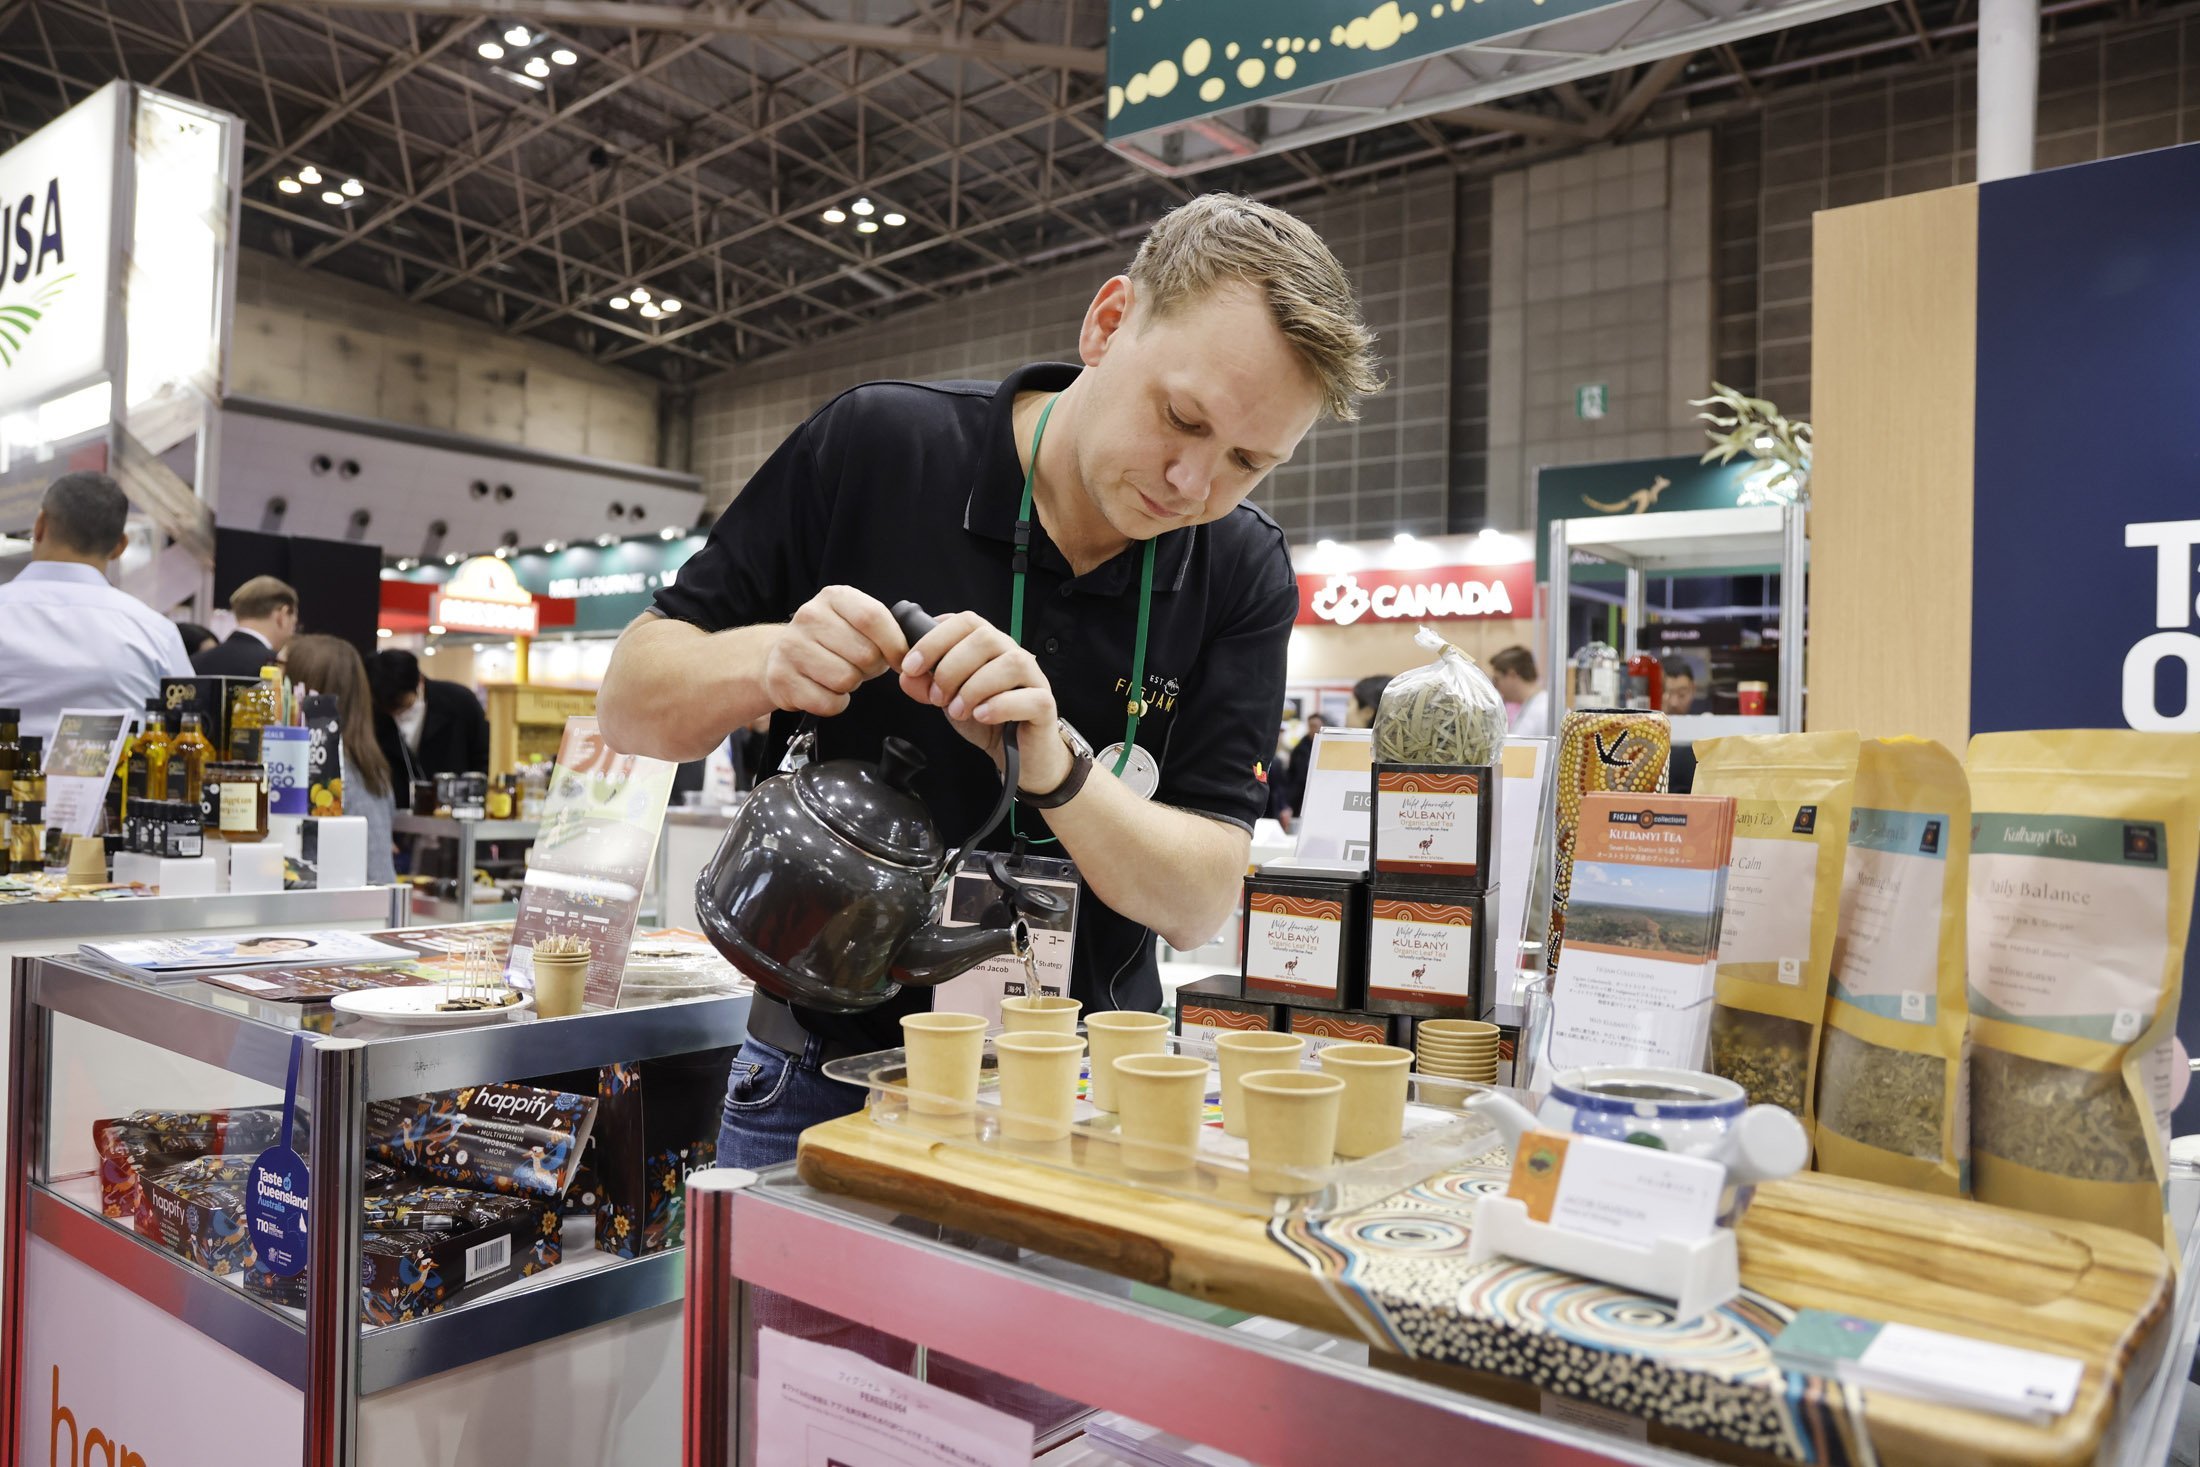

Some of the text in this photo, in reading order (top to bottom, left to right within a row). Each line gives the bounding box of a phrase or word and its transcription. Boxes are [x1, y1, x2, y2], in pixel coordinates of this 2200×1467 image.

[1371, 580, 1513, 619] CANADA
[1399, 811, 1456, 820] KULBANYI
[1612, 813, 1686, 824] FIGJAM collections
[1400, 819, 1426, 828] Organic
[1441, 820, 1454, 828] Tea
[2054, 828, 2078, 848] Tea
[1738, 857, 1763, 871] Calm
[2020, 881, 2091, 906] Balance
[1267, 931, 1319, 944] KULBANYI
[1269, 940, 1292, 949] Organic
[1392, 939, 1449, 951] KULBANYI
[1394, 947, 1419, 956] Organic
[987, 965, 1009, 973] Jacob
[1039, 960, 1063, 970] Strategy
[474, 1086, 554, 1121] happify
[499, 1124, 525, 1134] PROTEIN
[481, 1130, 524, 1142] MULTIVITAMIN
[483, 1139, 516, 1150] PROBIOTIC
[489, 1148, 506, 1157] MORE
[258, 1166, 283, 1187] Taste
[257, 1180, 308, 1211] Queensland
[152, 1187, 185, 1225] happify
[257, 1196, 286, 1213] Australia
